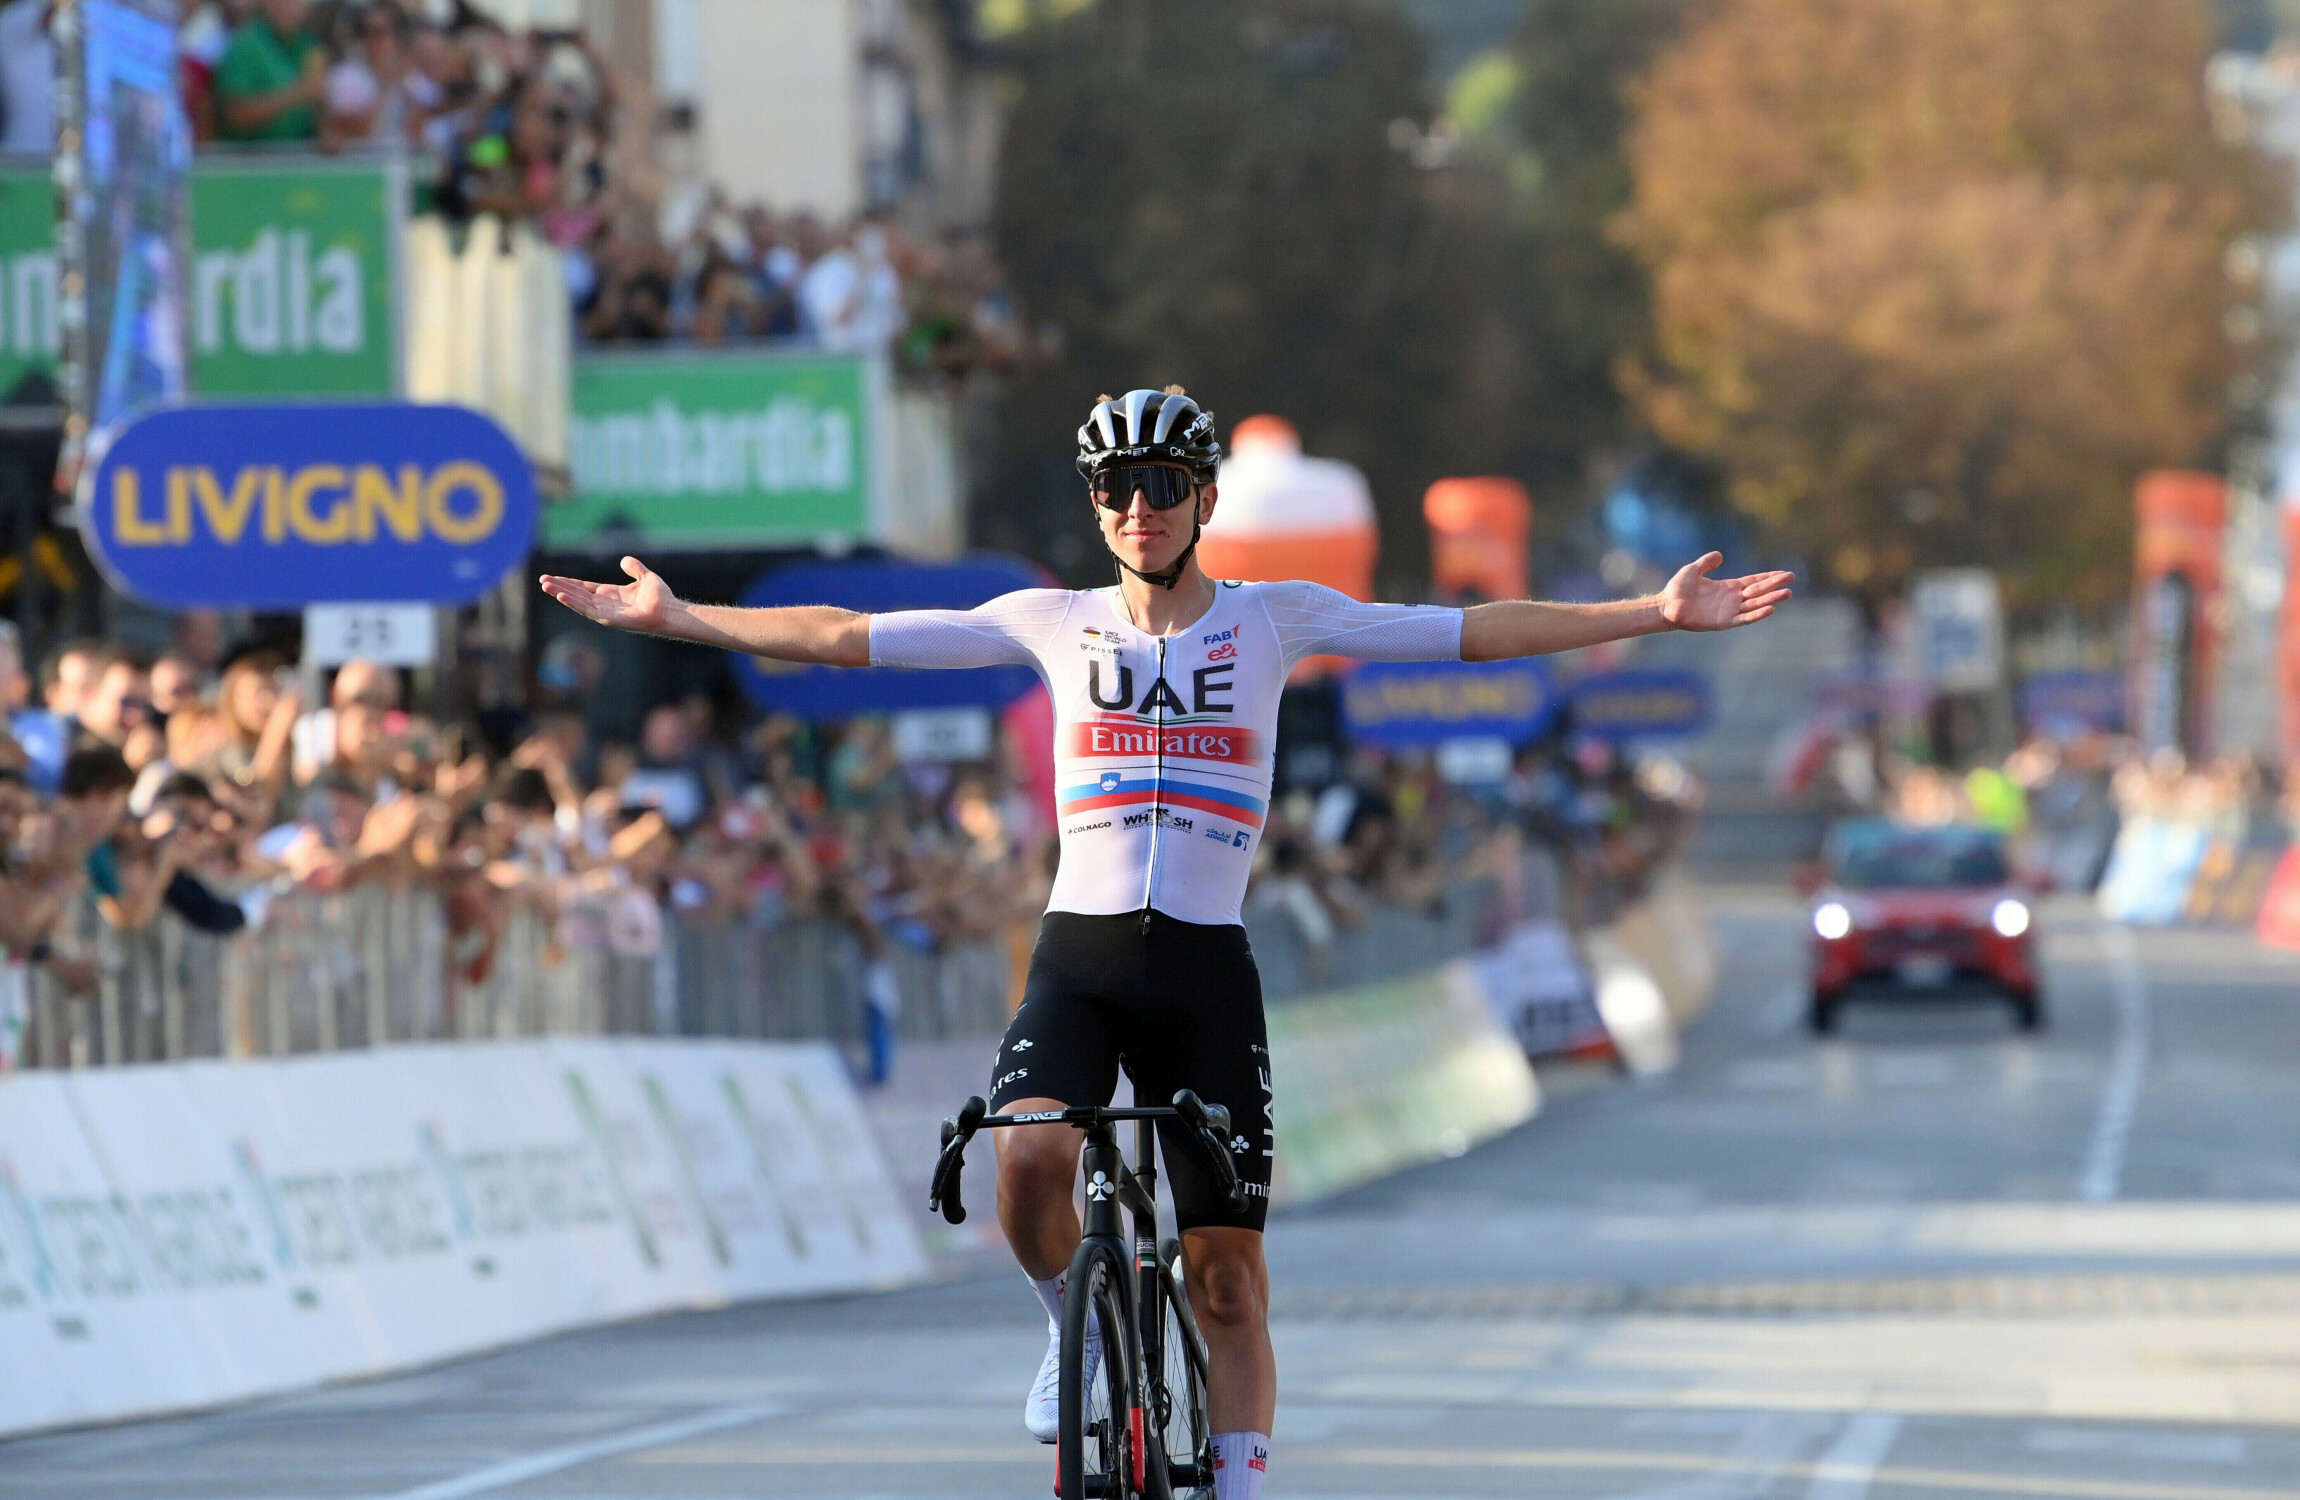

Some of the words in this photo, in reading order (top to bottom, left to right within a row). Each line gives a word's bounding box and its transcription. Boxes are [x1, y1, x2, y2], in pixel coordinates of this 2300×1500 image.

[1117, 446, 1150, 457] MET
[112, 460, 507, 546] LIVIGNO
[1089, 659, 1235, 716] UAE
[1090, 727, 1231, 757] Emirates
[1073, 821, 1112, 834] COLNAGO
[1205, 833, 1229, 844] ADNOC
